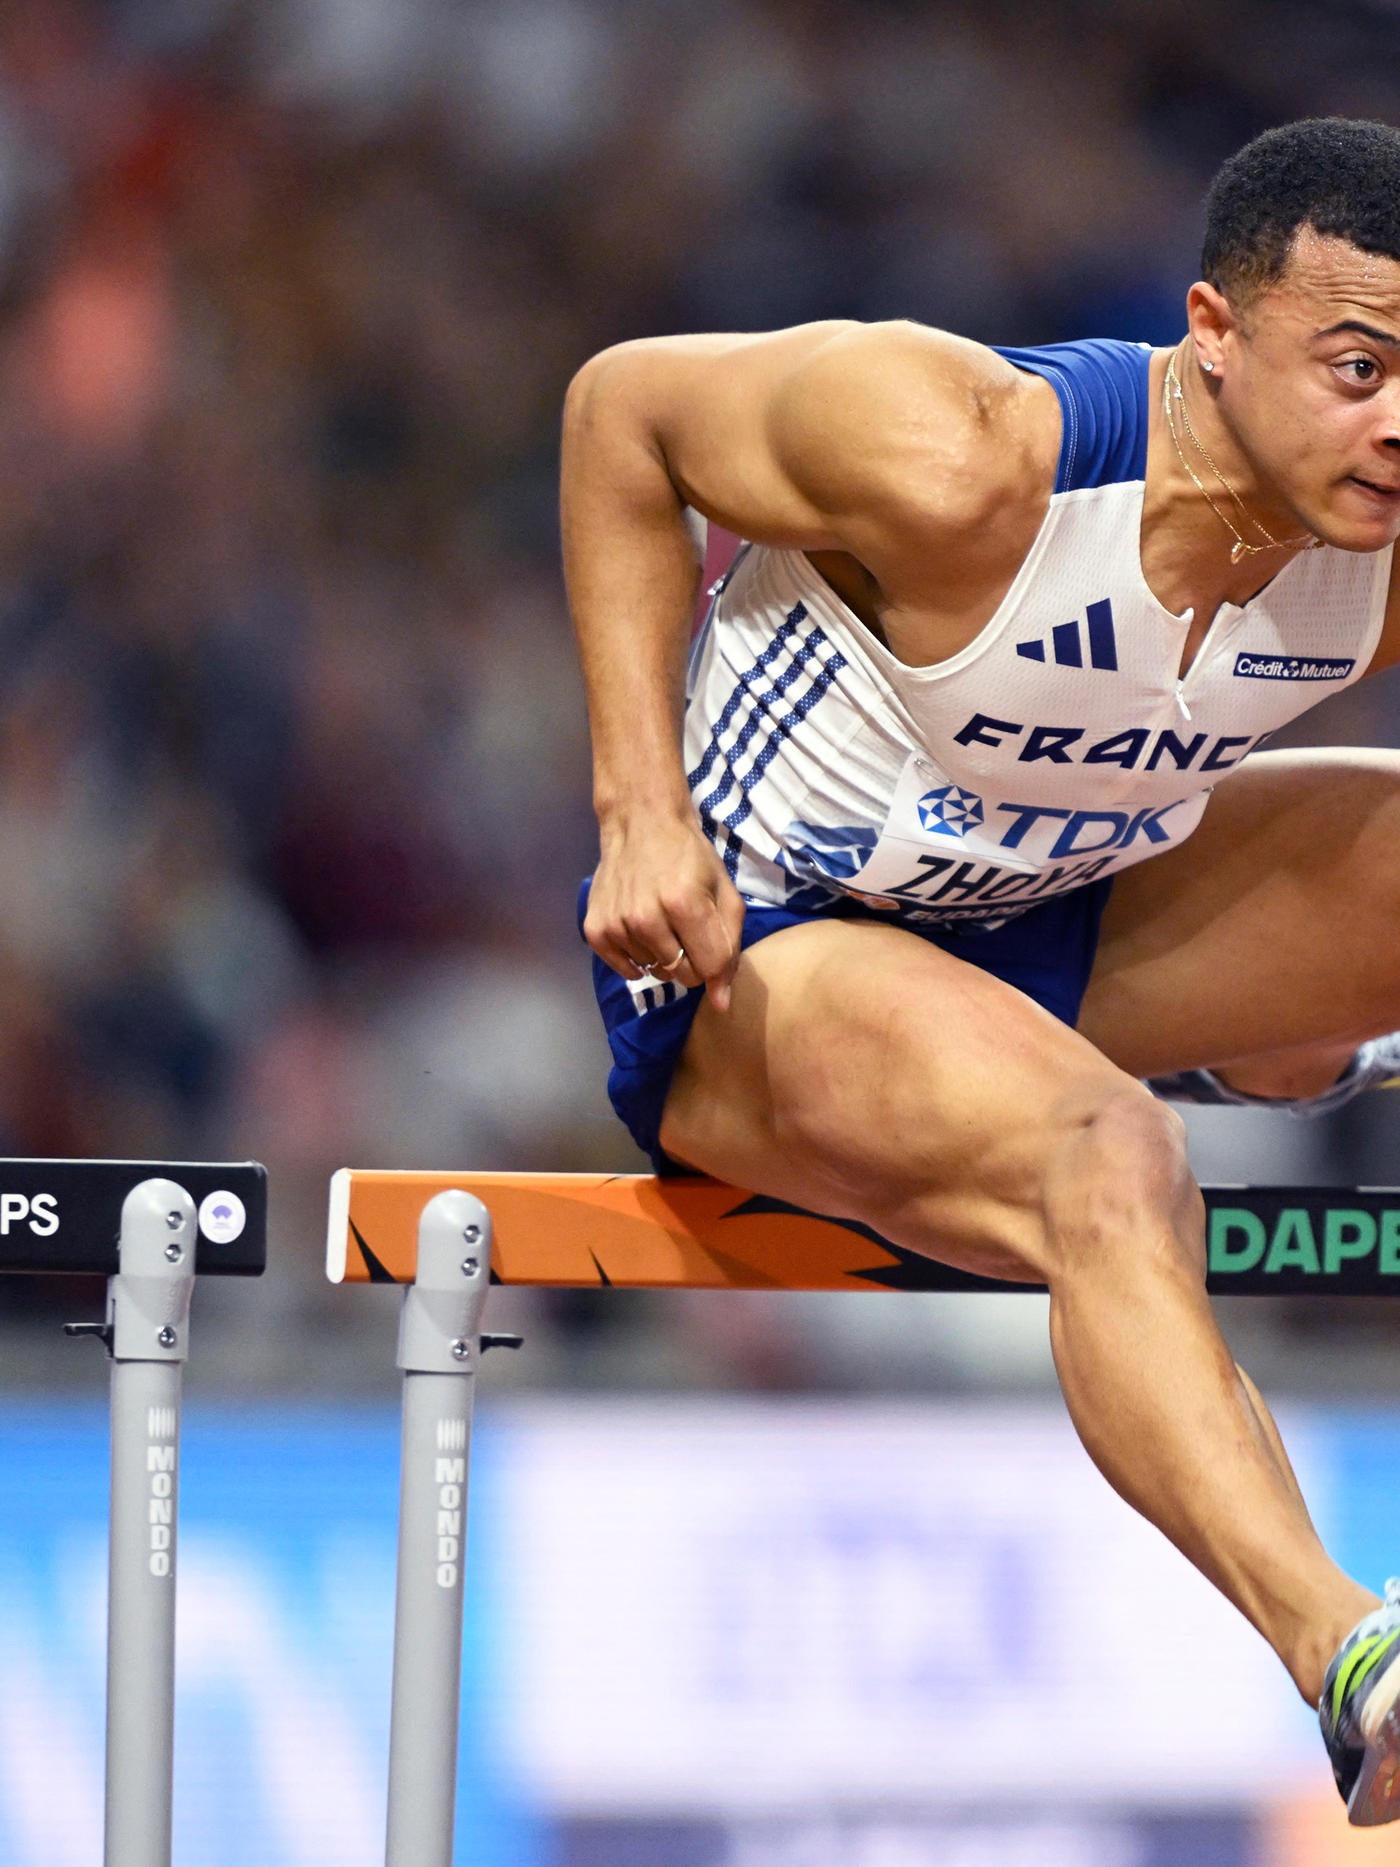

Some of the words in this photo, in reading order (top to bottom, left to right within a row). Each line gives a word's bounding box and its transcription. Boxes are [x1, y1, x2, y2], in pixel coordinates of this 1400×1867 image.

[1237, 657, 1283, 677] Crédit
[1300, 663, 1351, 678] Mutuel
[953, 712, 1272, 772] FRANC
[996, 799, 1189, 859] TDK
[883, 853, 1119, 901] ZHOYA
[0, 1193, 60, 1237] PS
[147, 1445, 175, 1577] MONDO
[435, 1457, 465, 1588] MONDO
